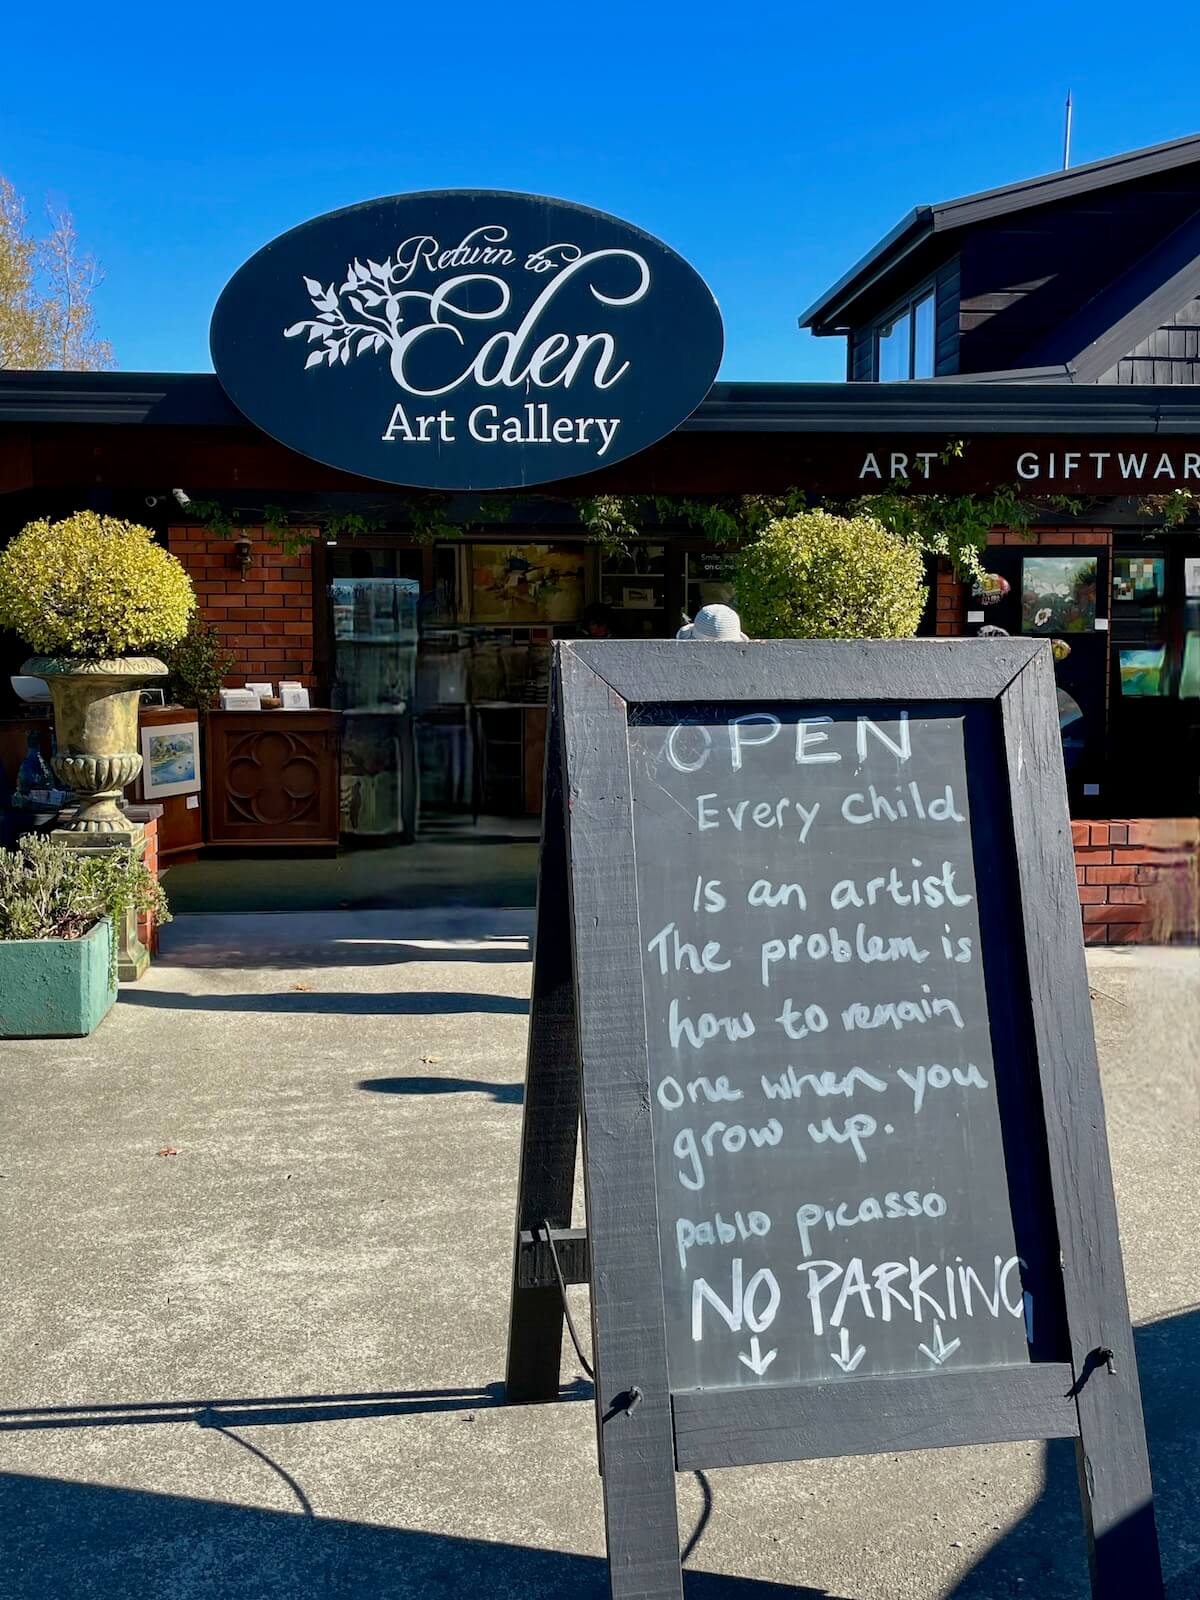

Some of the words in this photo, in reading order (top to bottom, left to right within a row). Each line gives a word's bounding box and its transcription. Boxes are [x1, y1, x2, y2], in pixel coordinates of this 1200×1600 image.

[393, 225, 516, 284] Return
[524, 243, 582, 274] to
[388, 248, 651, 397] Eden
[382, 403, 455, 442] Art
[468, 404, 621, 456] Gallery
[858, 452, 939, 479] ART
[666, 711, 912, 772] OPEN
[696, 793, 820, 843] Every
[748, 878, 807, 911] an
[830, 858, 974, 910] artist
[647, 922, 732, 975] The
[761, 922, 930, 987] problem
[941, 923, 973, 963] is
[668, 998, 755, 1049] how
[775, 998, 828, 1040] to
[841, 983, 965, 1031] remain
[761, 1064, 888, 1100] when
[897, 1063, 989, 1114] you
[673, 1117, 784, 1191] grow
[807, 1113, 895, 1163] up.
[691, 1257, 782, 1342] NO
